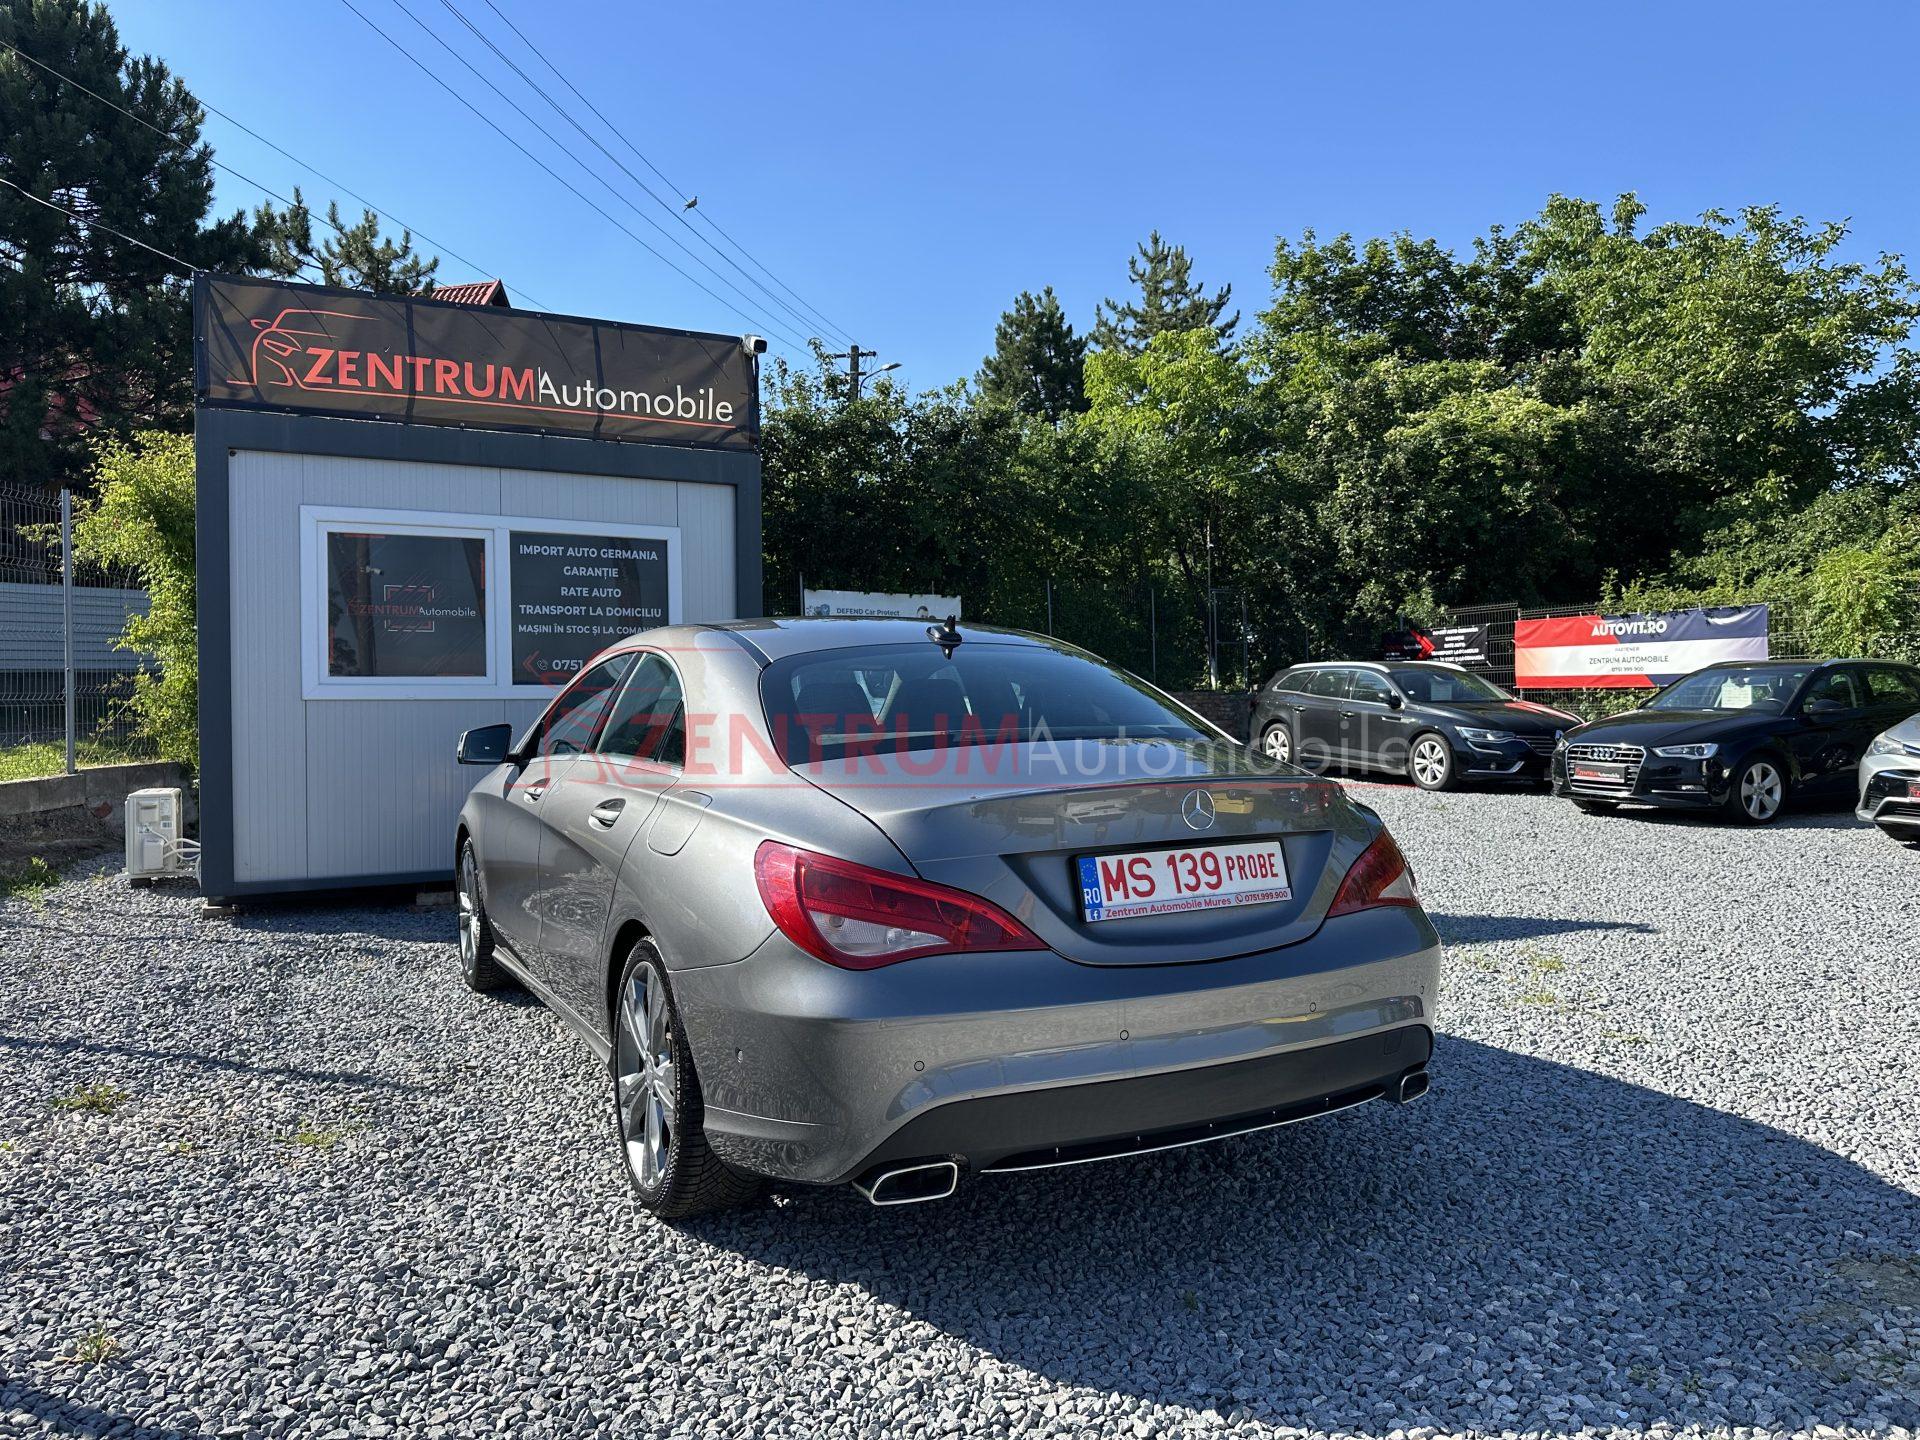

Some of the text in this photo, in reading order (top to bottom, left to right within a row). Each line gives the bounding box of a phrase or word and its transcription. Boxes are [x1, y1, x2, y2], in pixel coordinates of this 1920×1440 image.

[303, 347, 733, 422] ZENTRUM Automobile
[519, 545, 658, 560] IMPORT AUTO GERMANIA
[563, 566, 619, 580] GARANȚIE
[561, 587, 621, 598] RATE AUTO
[519, 604, 661, 617] TRANSPORT LA DOMICILIU
[836, 607, 864, 615] DEFEND
[864, 608, 876, 616] Car
[518, 624, 551, 635] MAȘINI
[554, 623, 564, 633] ÎN
[566, 625, 590, 634] STOC
[602, 626, 614, 634] LA
[1591, 620, 1667, 637] AUTOVIT.RO
[1589, 655, 1669, 665] ZENTRUM AUTOMOBILE
[1101, 851, 1279, 901] MS 139 PROBE
[1083, 887, 1100, 905] RO
[1105, 905, 1148, 918] Zentrum
[1150, 900, 1202, 914] Automobile
[1204, 896, 1232, 908] Mures
